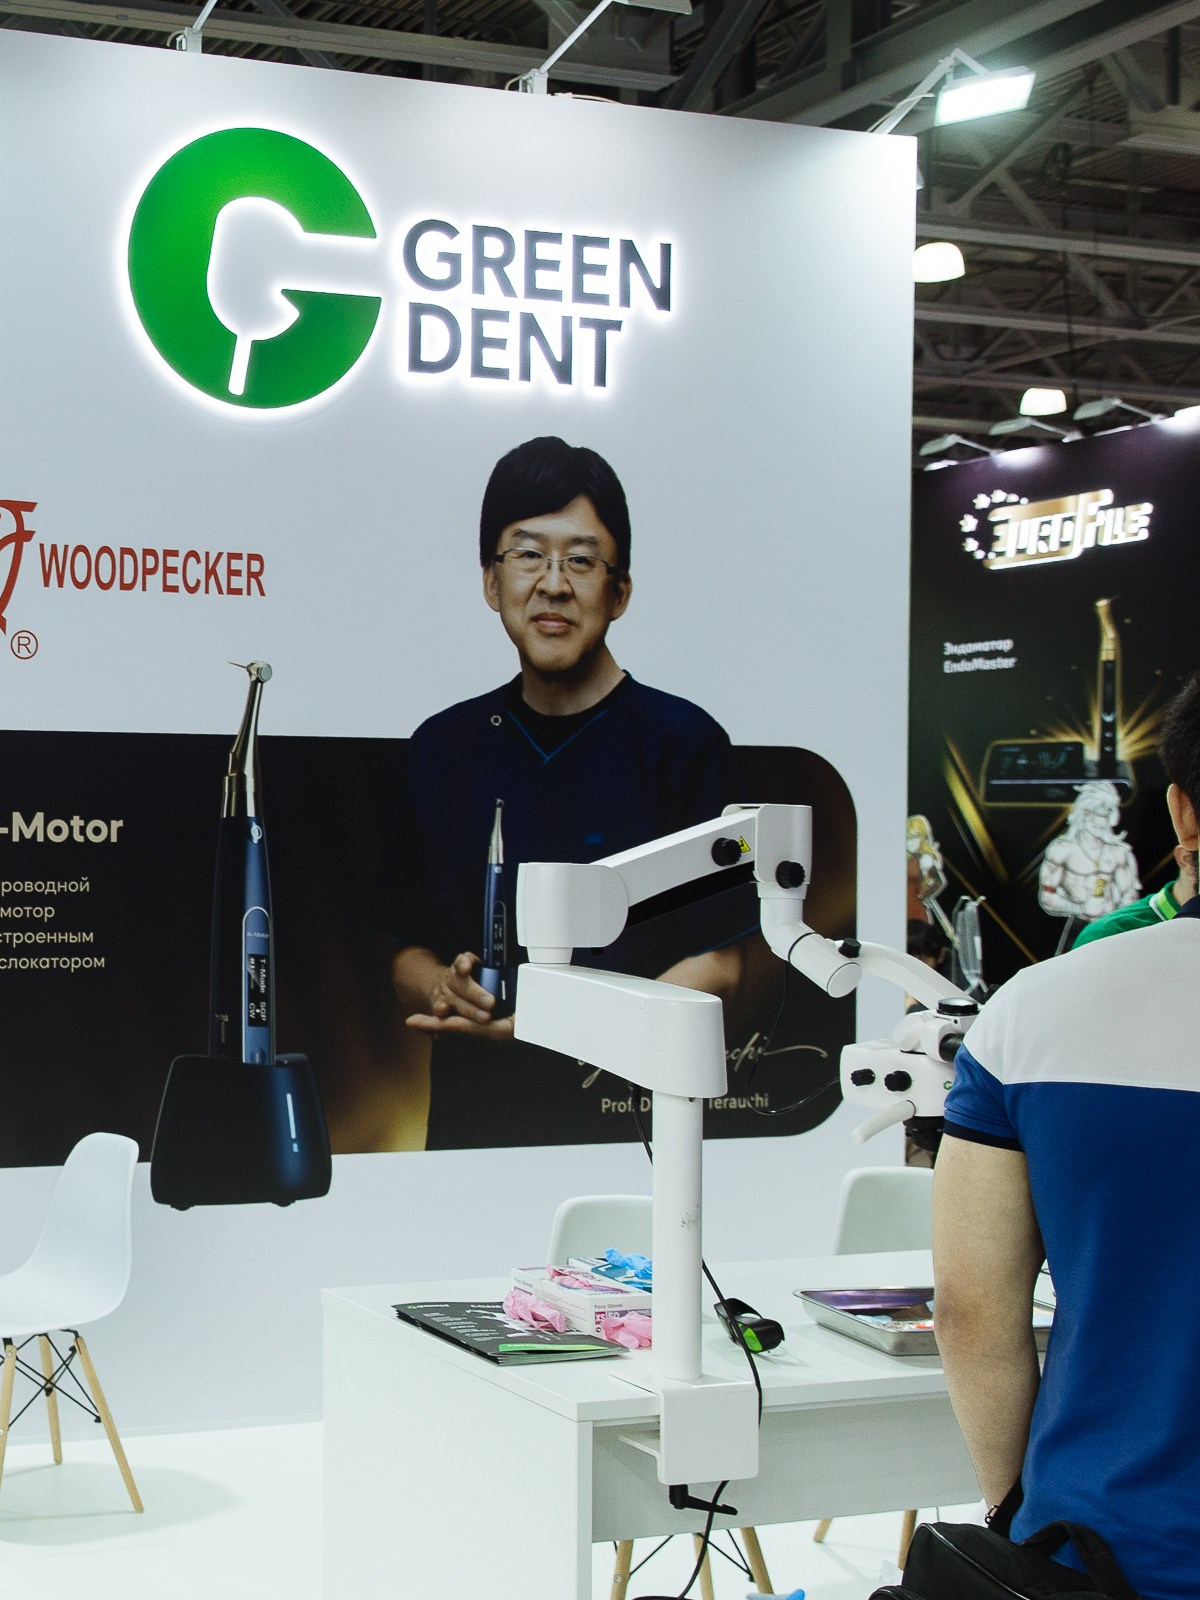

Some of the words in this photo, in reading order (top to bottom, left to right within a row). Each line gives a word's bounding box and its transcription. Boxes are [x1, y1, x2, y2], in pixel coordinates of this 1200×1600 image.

[402, 218, 673, 312] GREEN
[407, 301, 623, 388] DENT
[38, 542, 267, 597] WOODPECKER
